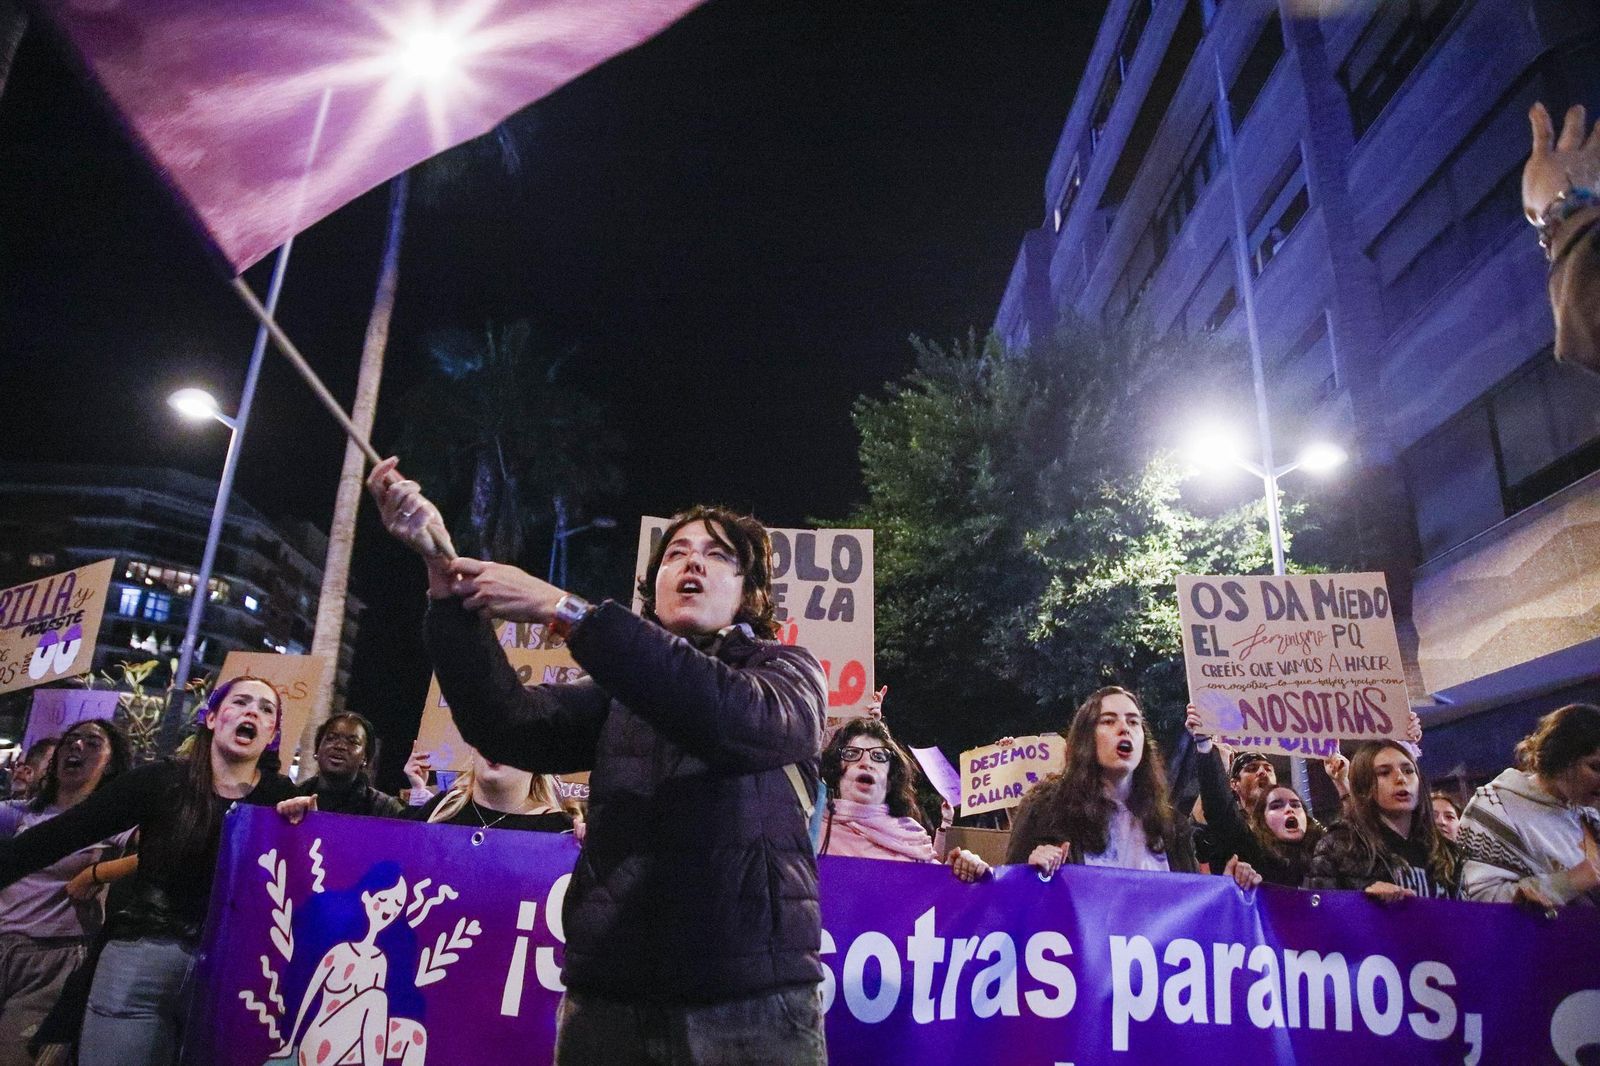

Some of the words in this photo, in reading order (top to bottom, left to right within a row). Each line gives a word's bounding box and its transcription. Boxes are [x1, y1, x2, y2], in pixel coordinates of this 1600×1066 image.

[770, 531, 863, 583] OLO
[771, 583, 788, 621] E
[804, 585, 854, 622] LA
[1191, 582, 1249, 622] OS
[1260, 580, 1309, 622] DA
[1191, 624, 1229, 657] EL
[1331, 622, 1365, 649] PQ
[1249, 662, 1277, 677] QUE
[1276, 657, 1323, 675] VAMOS
[1328, 653, 1342, 673] A
[1344, 655, 1391, 672] HACER
[1294, 680, 1313, 688] que
[1238, 687, 1394, 734] NOSOTRAS
[970, 742, 1049, 774] DEJEMOS
[967, 782, 1025, 808] CALLAR
[971, 773, 991, 790] DE
[1109, 930, 1483, 1066] paramos,
